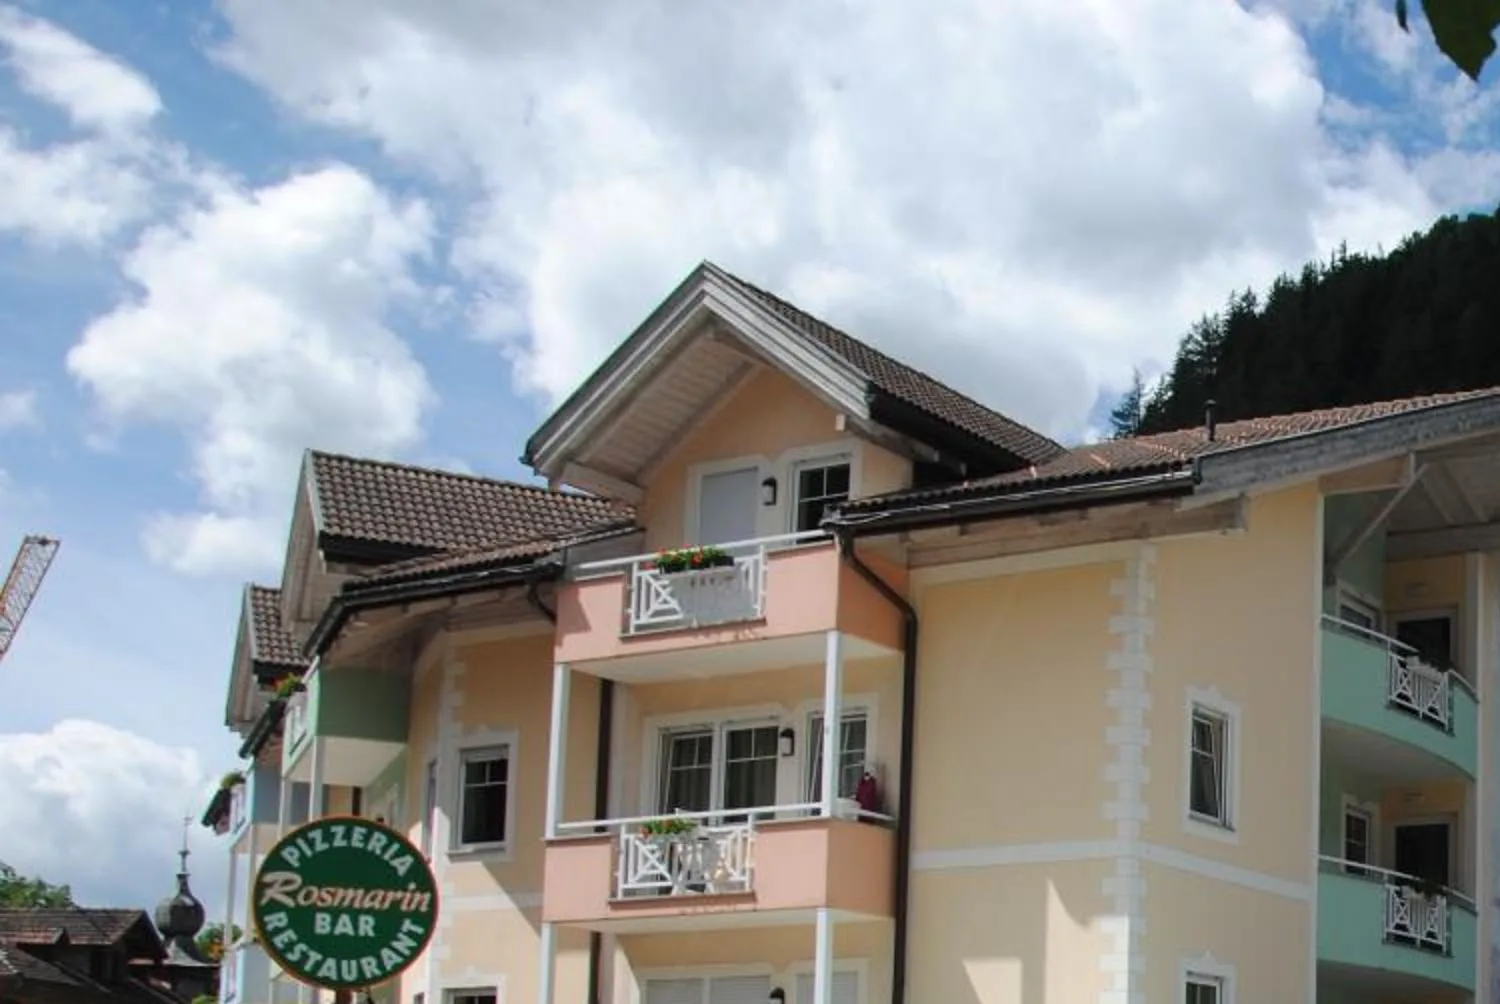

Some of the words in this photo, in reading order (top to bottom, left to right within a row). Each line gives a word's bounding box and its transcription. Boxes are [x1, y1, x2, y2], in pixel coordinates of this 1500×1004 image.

[281, 824, 415, 877] PIZZERIA
[259, 871, 432, 913] Rosmarin
[263, 911, 425, 982] RESTAURANT
[314, 912, 376, 937] BAR
